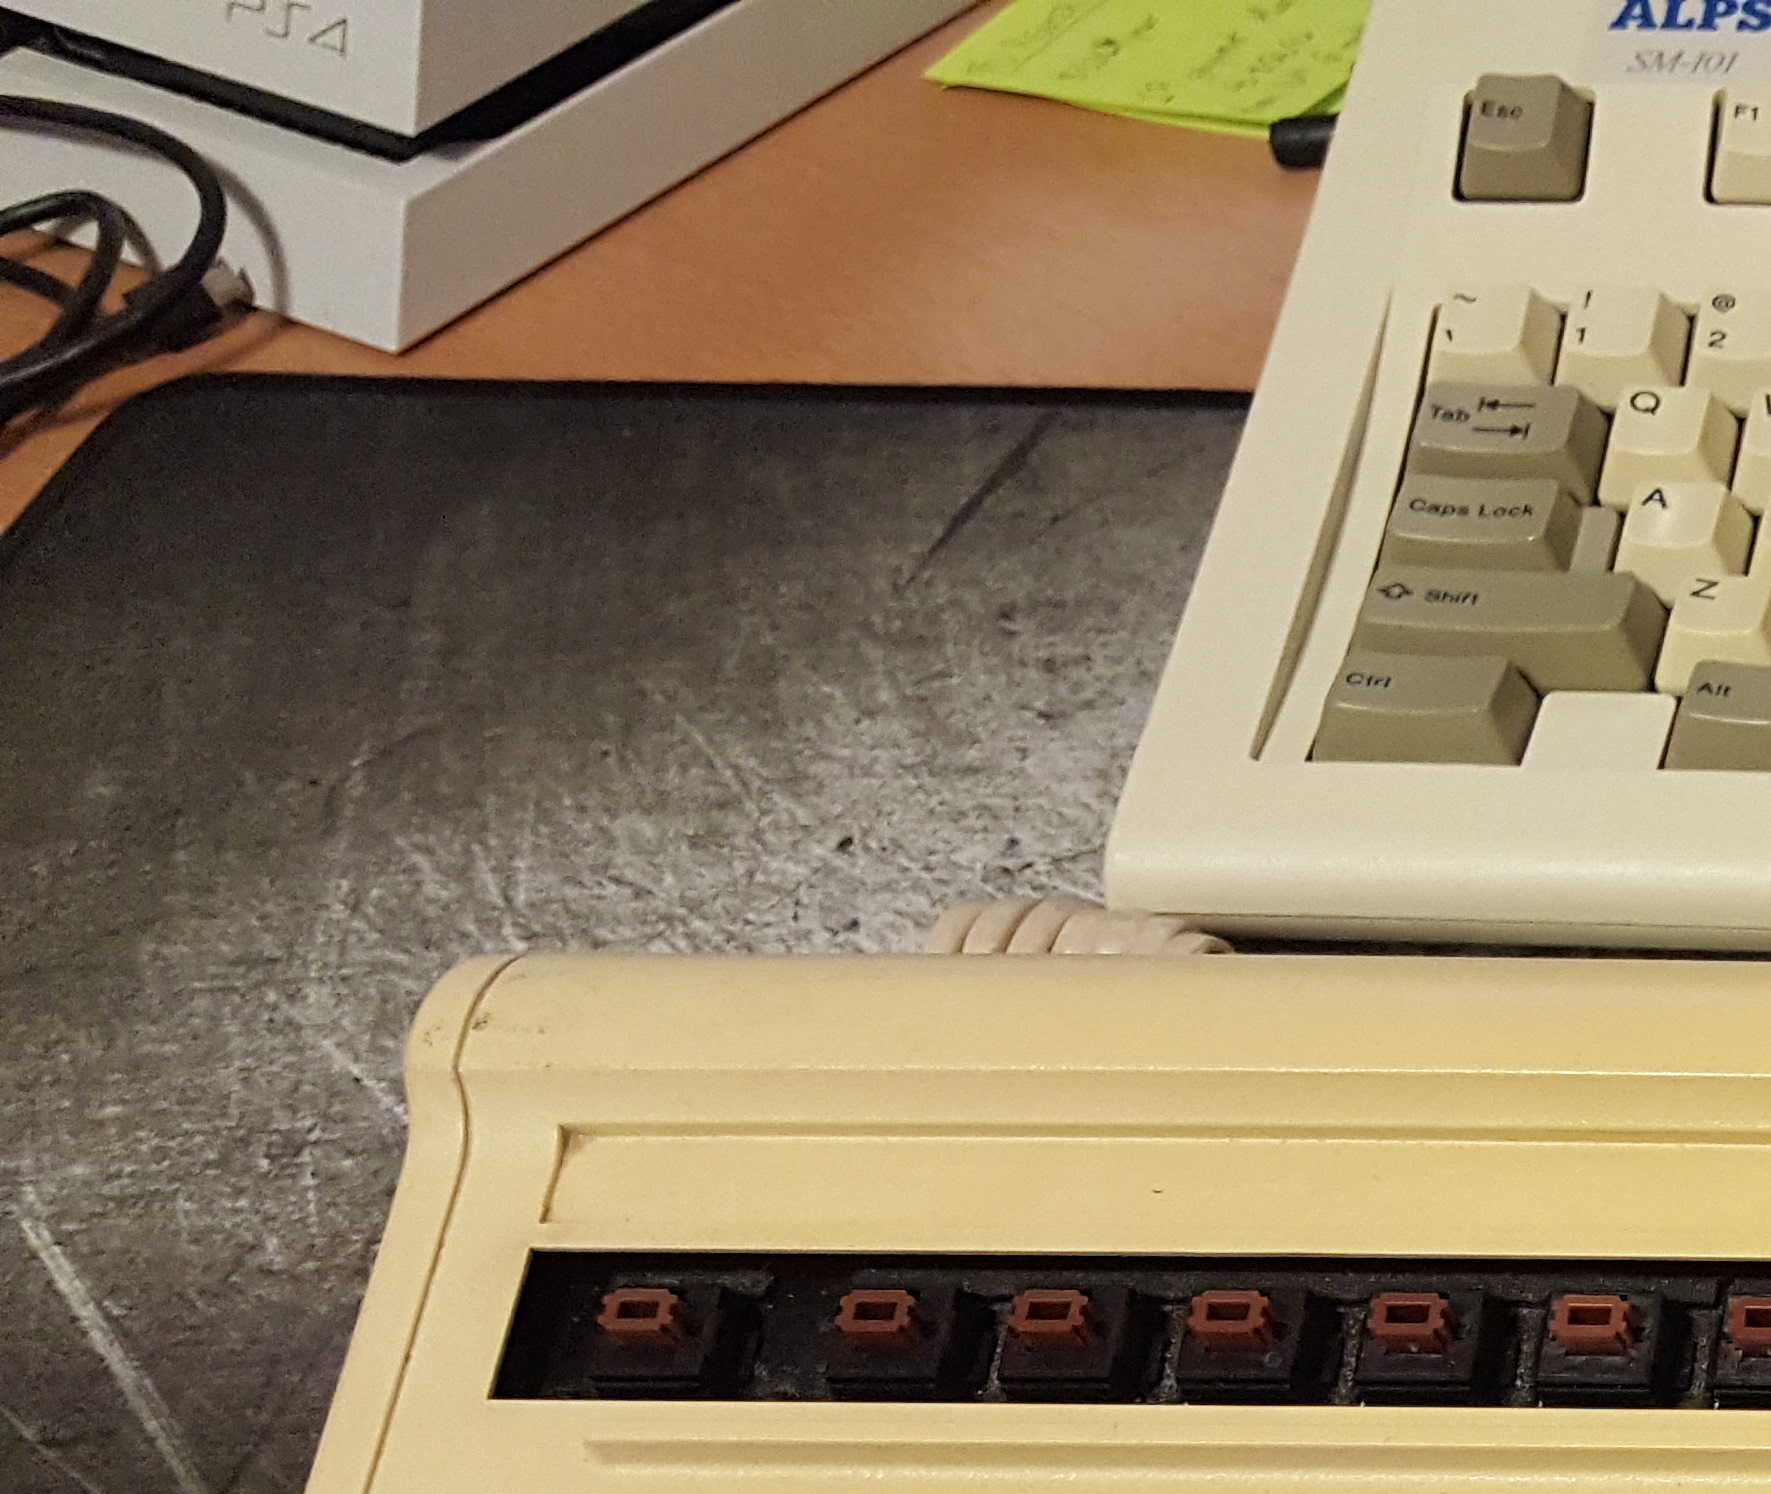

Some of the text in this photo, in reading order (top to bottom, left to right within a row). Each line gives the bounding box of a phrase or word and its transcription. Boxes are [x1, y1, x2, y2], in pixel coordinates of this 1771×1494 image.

[1481, 104, 1523, 120] Esc
[1733, 105, 1760, 121] F1
[1708, 331, 1726, 348] 2
[1629, 391, 1660, 415] Q
[1430, 404, 1470, 423] Tab
[1641, 488, 1669, 509] A
[1409, 498, 1534, 518] Caps Lock
[1424, 589, 1480, 605] Shift
[1690, 579, 1718, 600] Z
[1345, 673, 1390, 689] Ctrl
[1697, 681, 1731, 696] Alt
